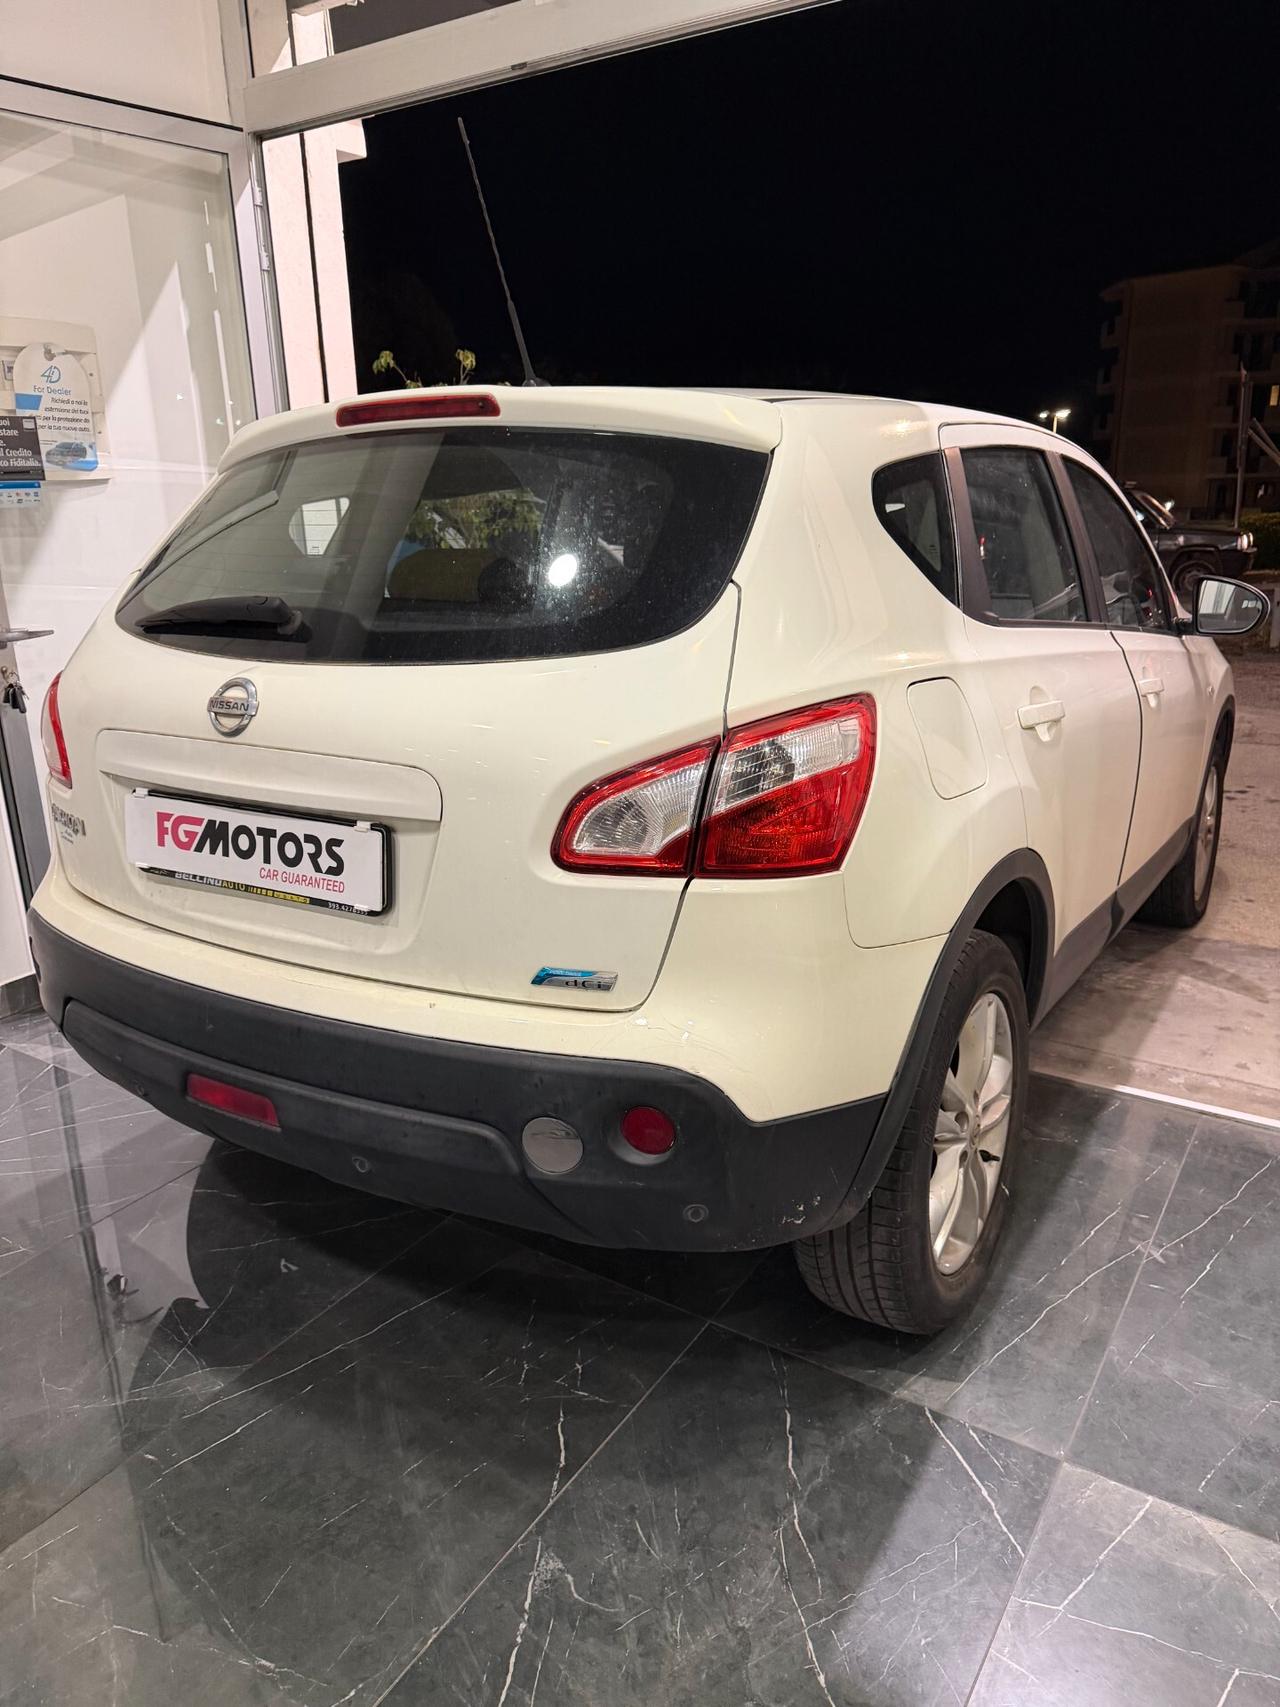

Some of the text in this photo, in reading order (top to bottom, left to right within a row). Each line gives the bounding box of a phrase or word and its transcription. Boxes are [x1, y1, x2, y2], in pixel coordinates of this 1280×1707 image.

[33, 385, 71, 395] For Dealer
[5, 448, 32, 457] Credito
[10, 458, 41, 467] Fiditalia.
[210, 699, 249, 712] NISSAN
[259, 867, 345, 894] CAR GUARANTEED
